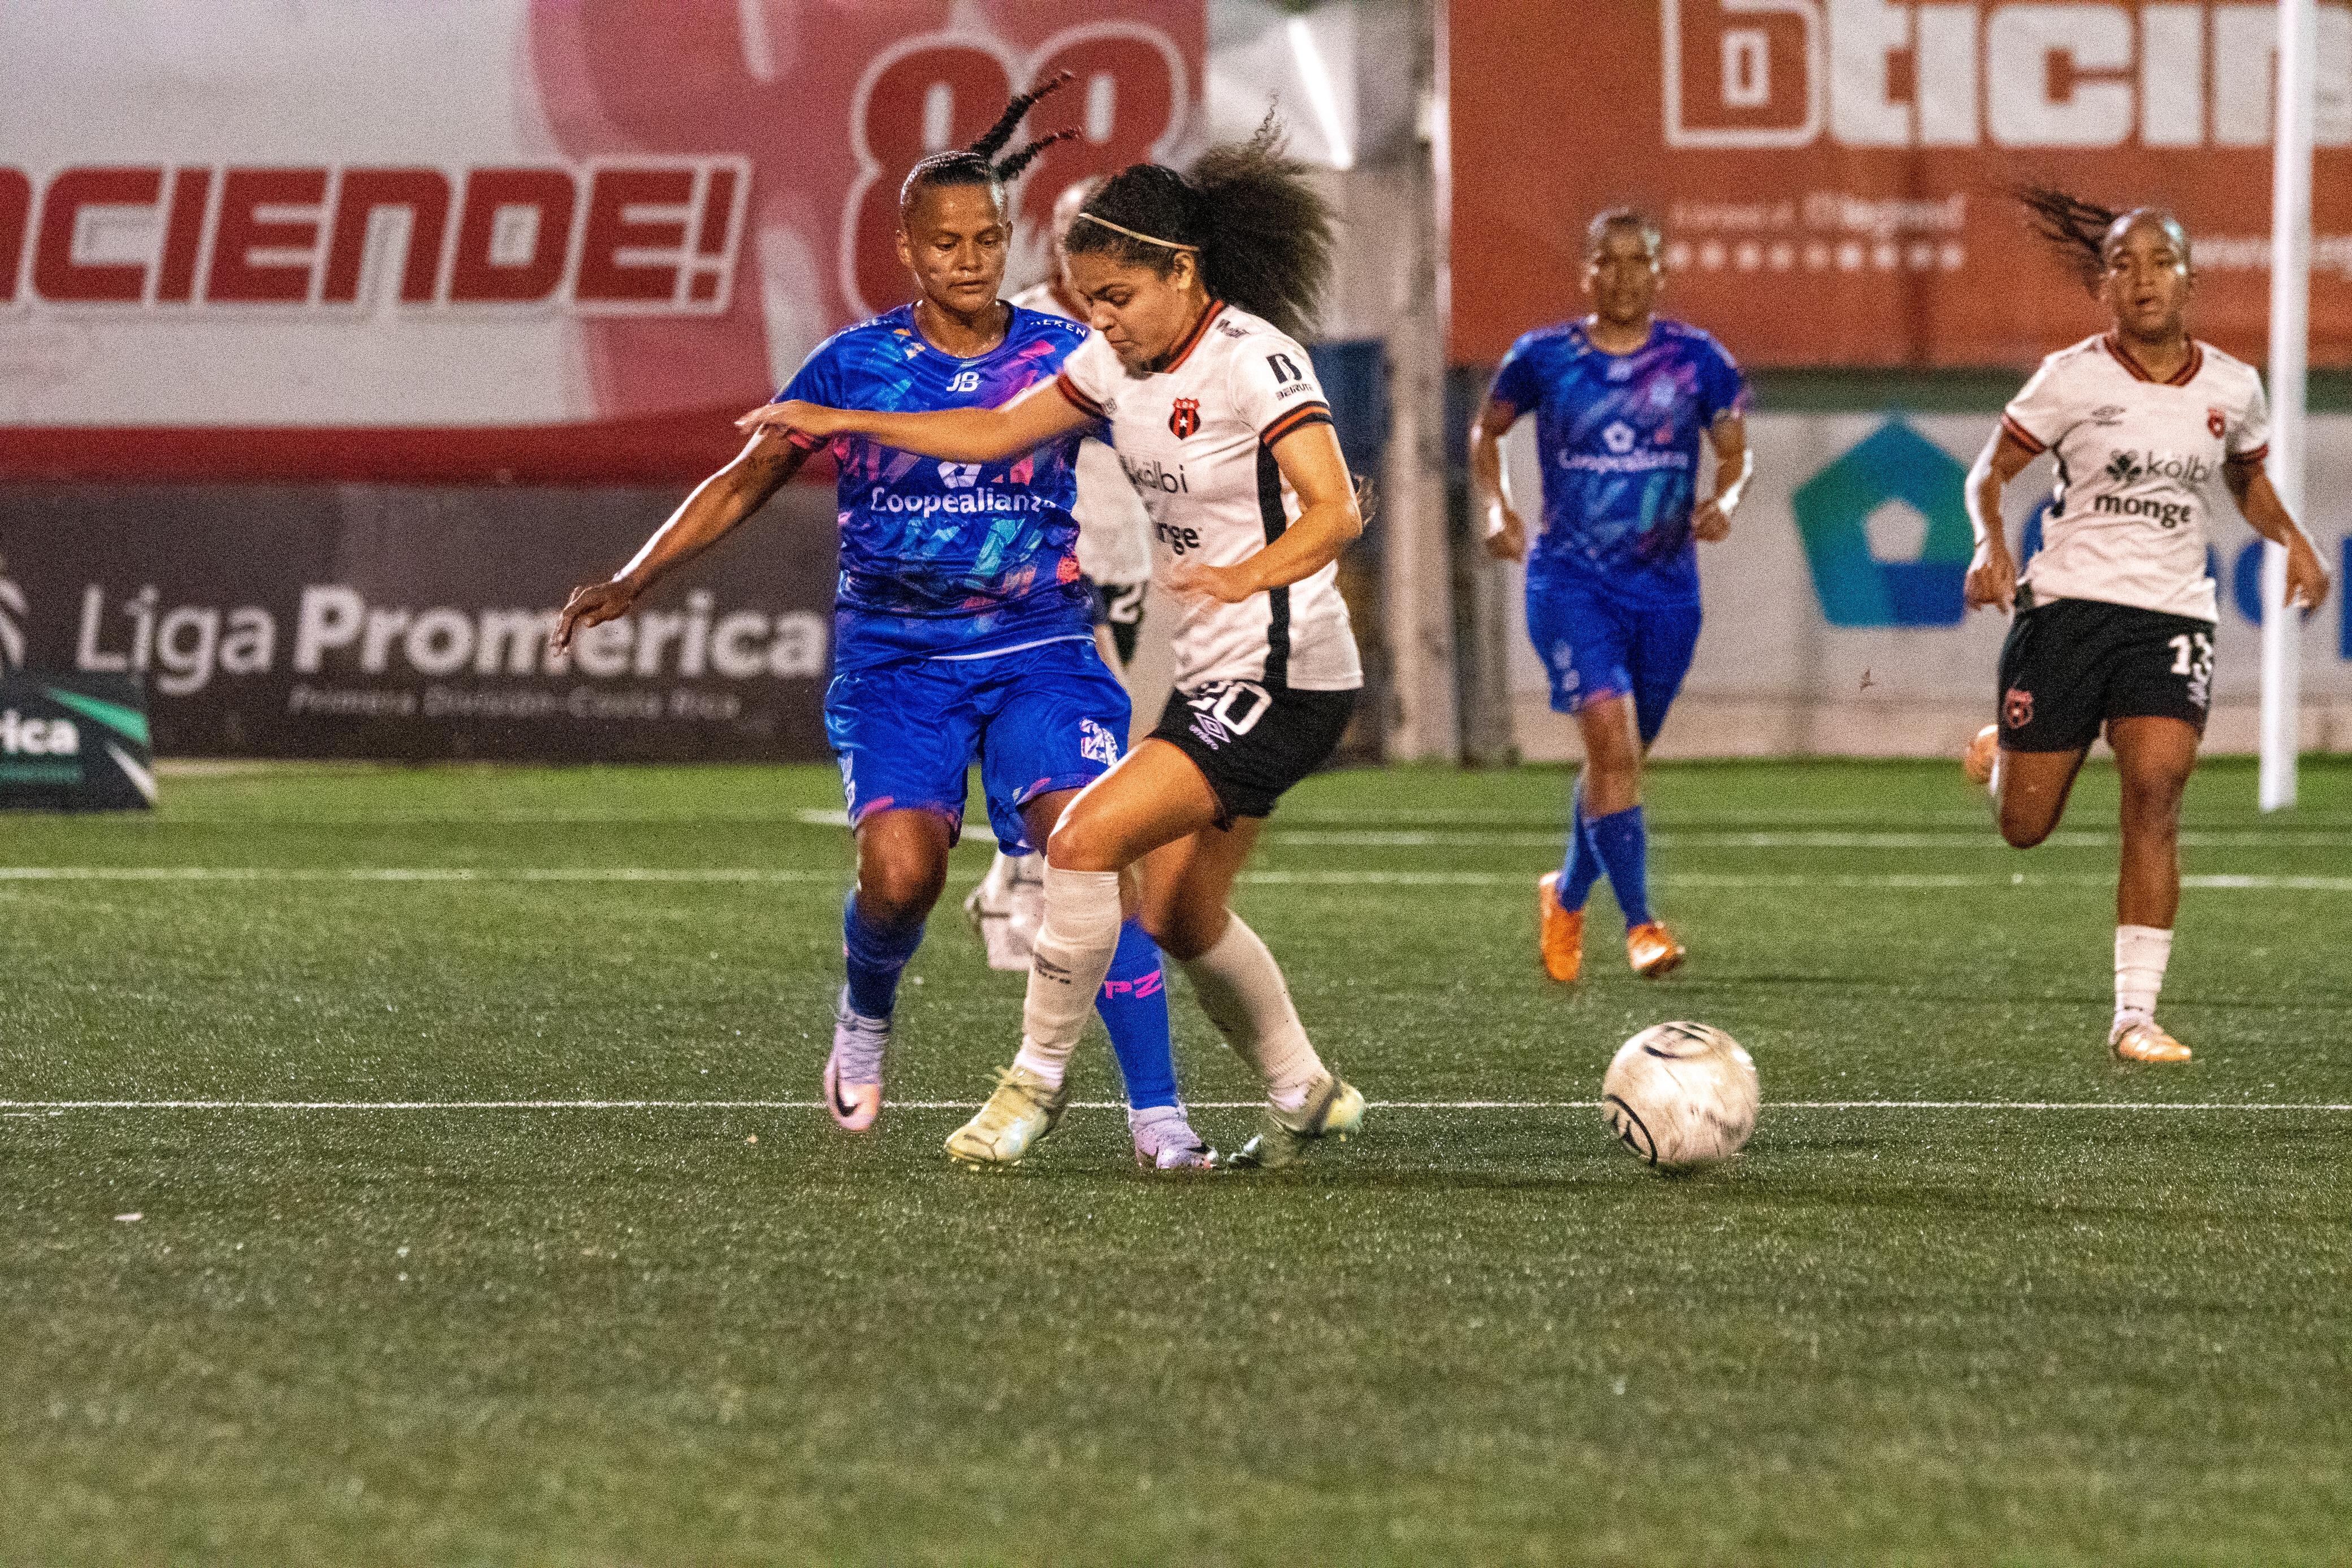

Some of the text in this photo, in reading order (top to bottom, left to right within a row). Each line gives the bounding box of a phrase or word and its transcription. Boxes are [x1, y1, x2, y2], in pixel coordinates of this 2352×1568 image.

[946, 372, 980, 392] JB
[76, 586, 827, 695] Liga Promerica
[1104, 969, 1162, 999] PZ
